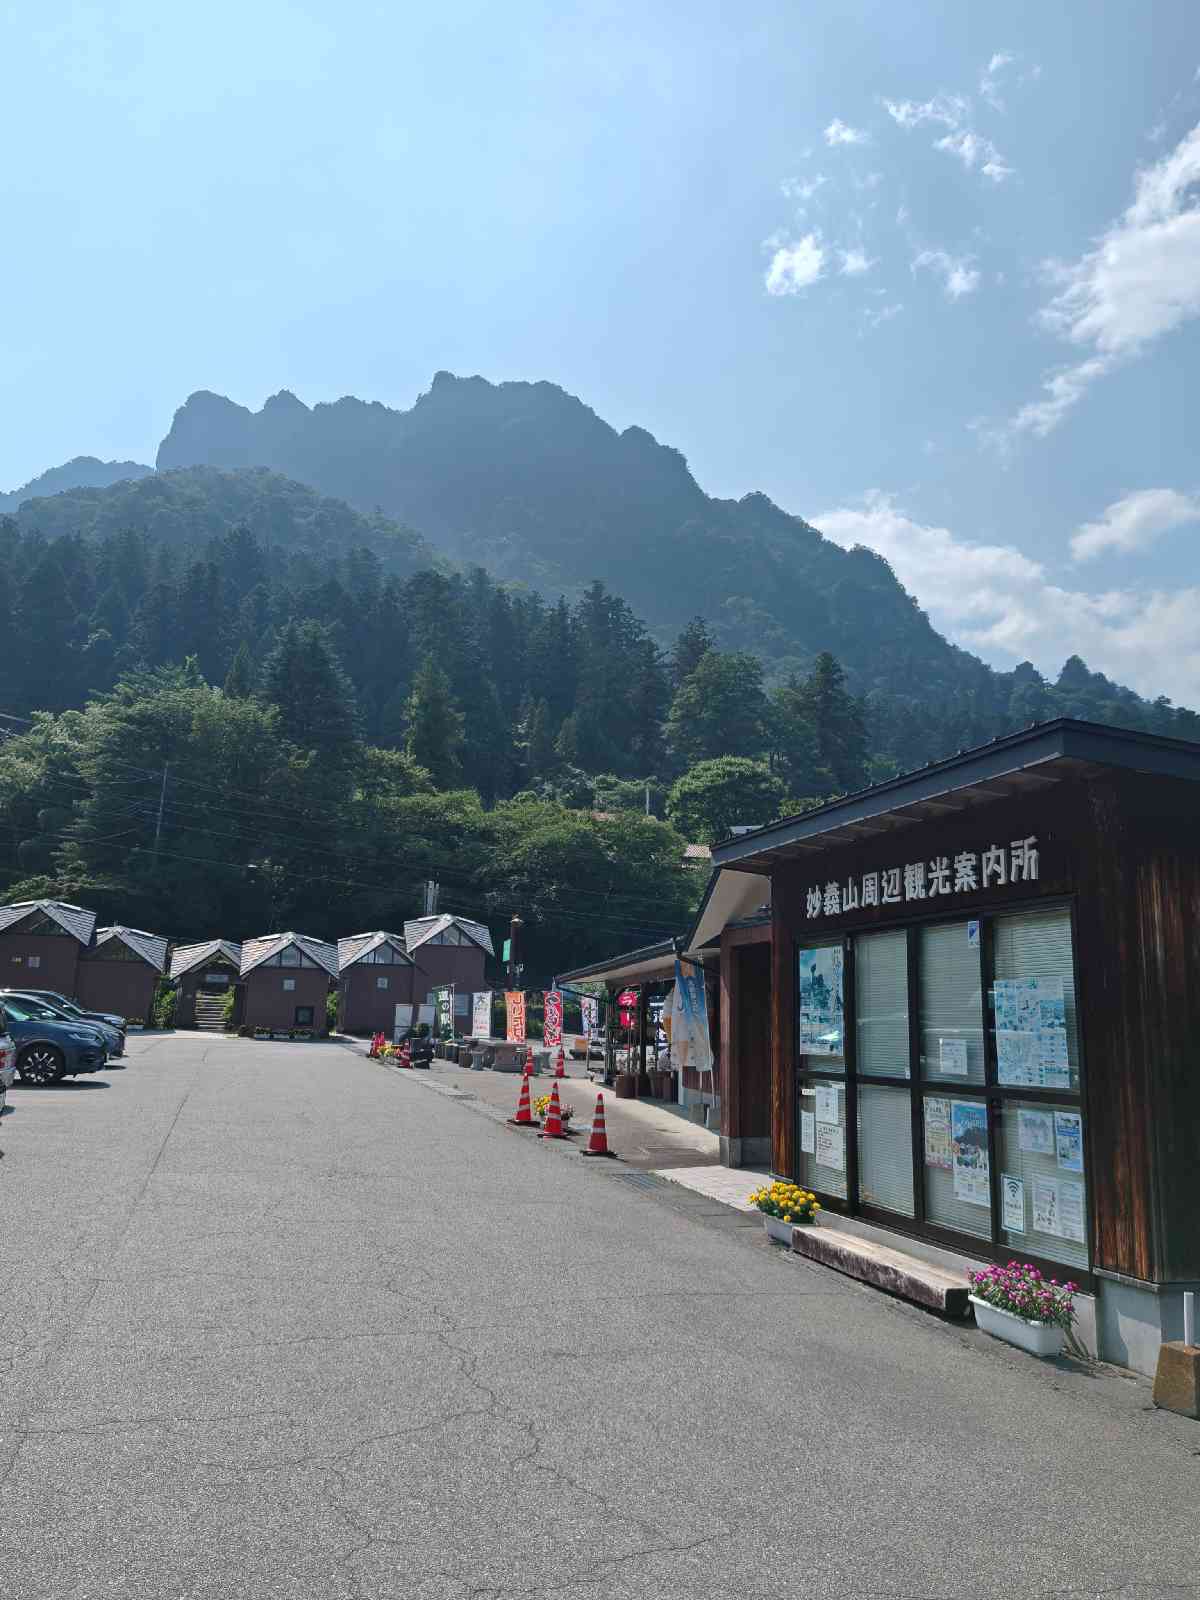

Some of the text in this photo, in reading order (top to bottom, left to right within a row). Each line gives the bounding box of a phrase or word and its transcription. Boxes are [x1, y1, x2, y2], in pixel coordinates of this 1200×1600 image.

[806, 836, 1039, 918] 妙義山周辺観光案内所
